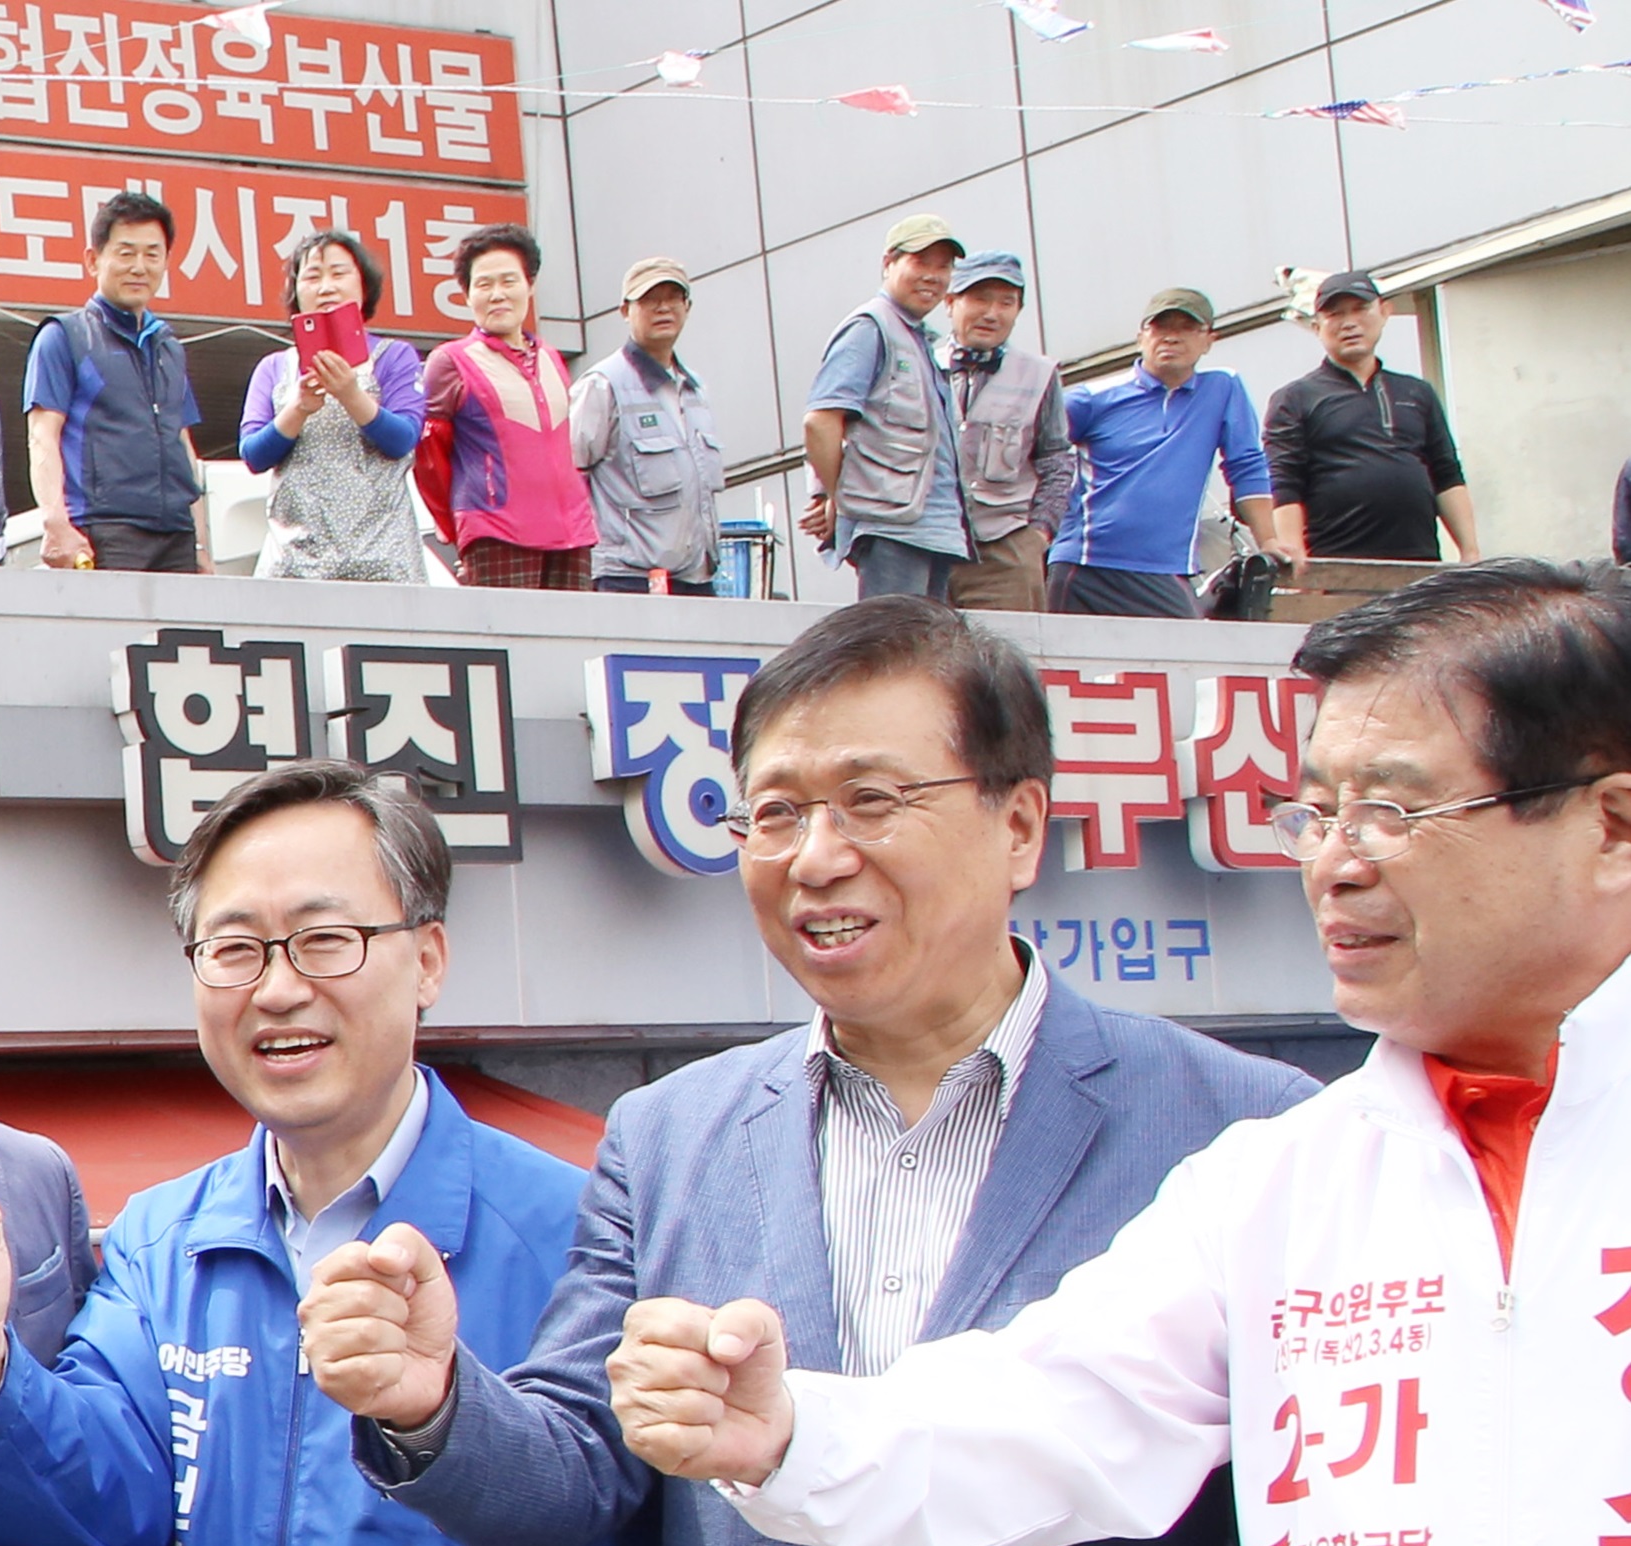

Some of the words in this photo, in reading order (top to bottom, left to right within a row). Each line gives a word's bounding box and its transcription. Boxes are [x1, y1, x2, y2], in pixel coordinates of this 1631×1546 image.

[129, 628, 523, 863] 협진
[158, 1343, 253, 1383] 어민주당
[1266, 1376, 1429, 1505] 2-가
